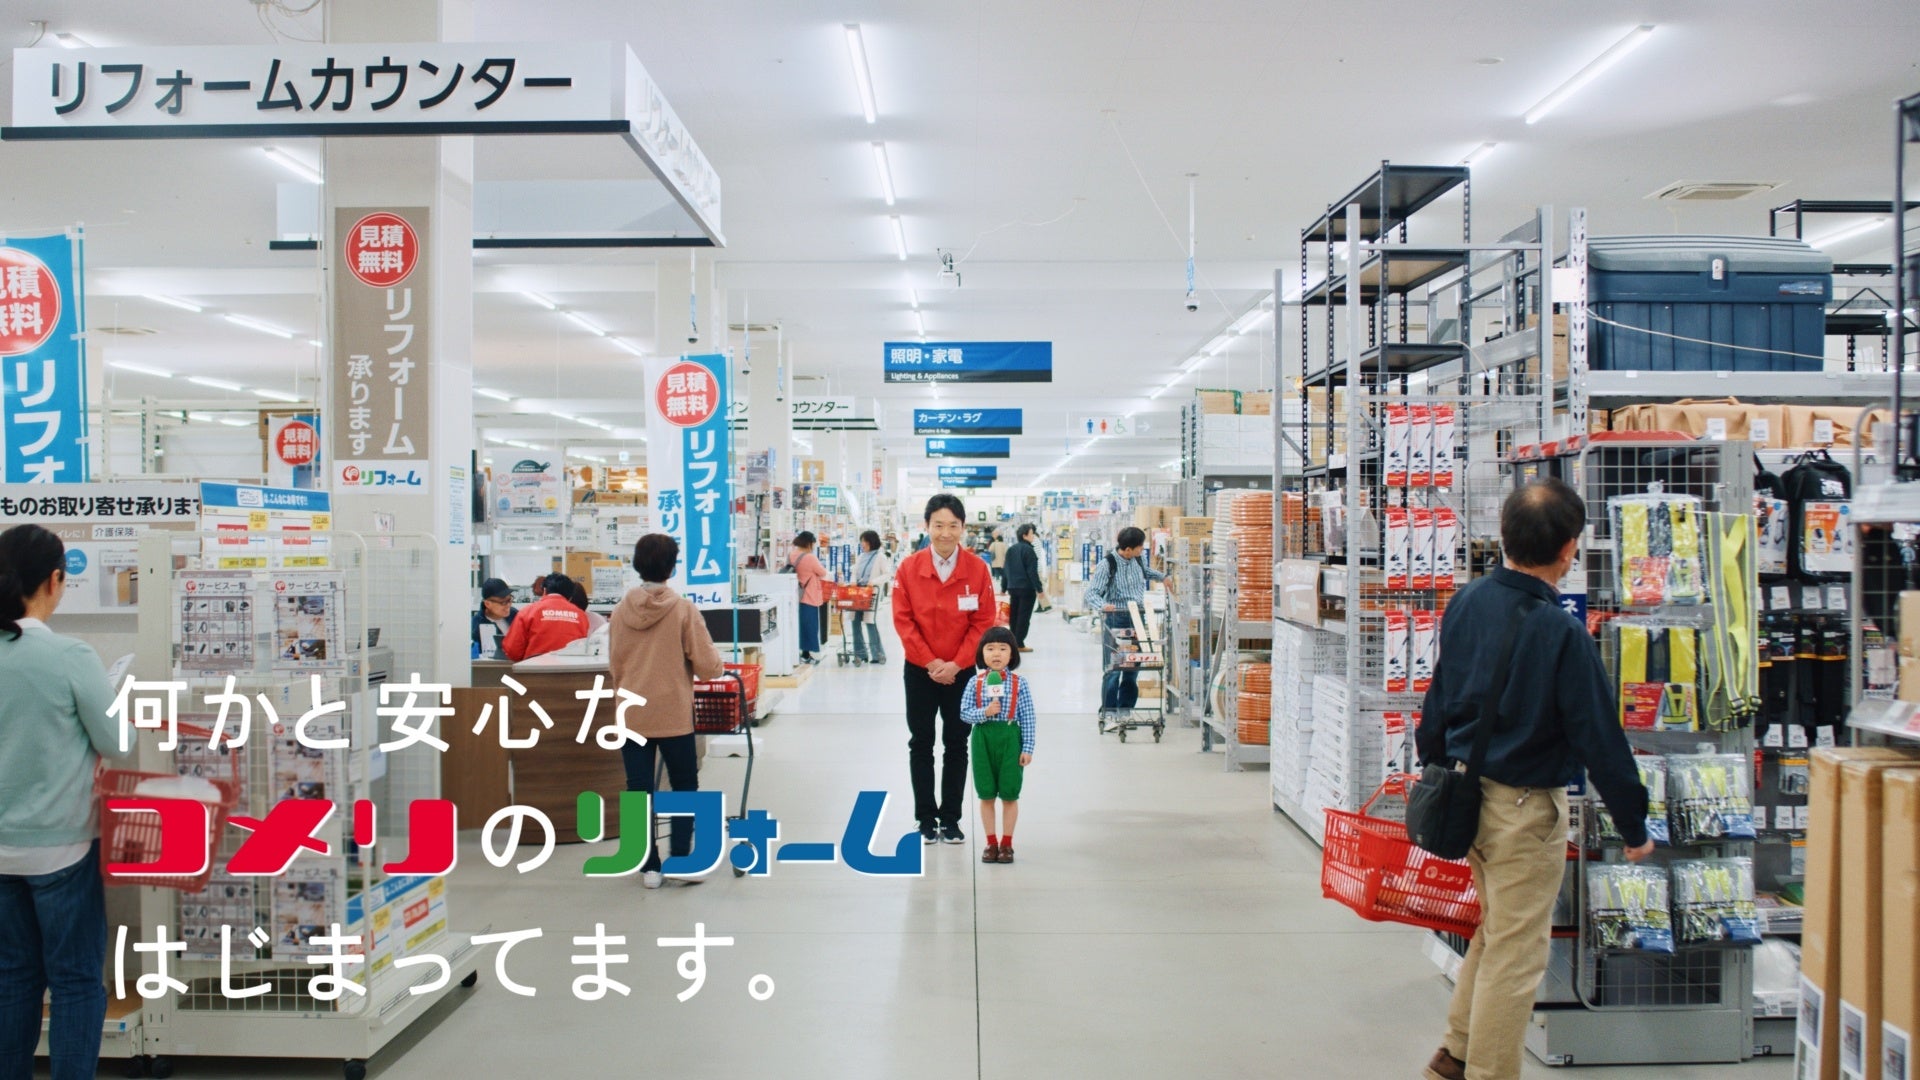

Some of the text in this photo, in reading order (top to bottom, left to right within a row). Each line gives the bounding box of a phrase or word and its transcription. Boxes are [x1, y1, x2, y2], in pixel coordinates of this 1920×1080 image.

[51, 57, 572, 115] リフォームカウンター
[358, 225, 404, 248] 見積
[358, 250, 404, 273] 無料
[0, 265, 42, 299] 積
[0, 302, 43, 336] 料
[891, 348, 963, 364] 照明・家電
[383, 288, 415, 455] リフォーム
[924, 373, 959, 381] Appliances
[666, 372, 708, 394] 見積
[347, 354, 373, 456] 承ります
[666, 394, 708, 417] 無料
[918, 413, 982, 423] カーテン・ラグ
[283, 428, 312, 443] 見積
[283, 444, 311, 459] 無料
[361, 470, 422, 485] リフォーム
[688, 430, 722, 577] リフォーム
[95, 527, 138, 537] 介護保険
[198, 581, 247, 590] サービス一覧
[288, 581, 337, 590] サービス一覧
[682, 591, 722, 604] フォーム
[542, 609, 578, 618] KOMERI
